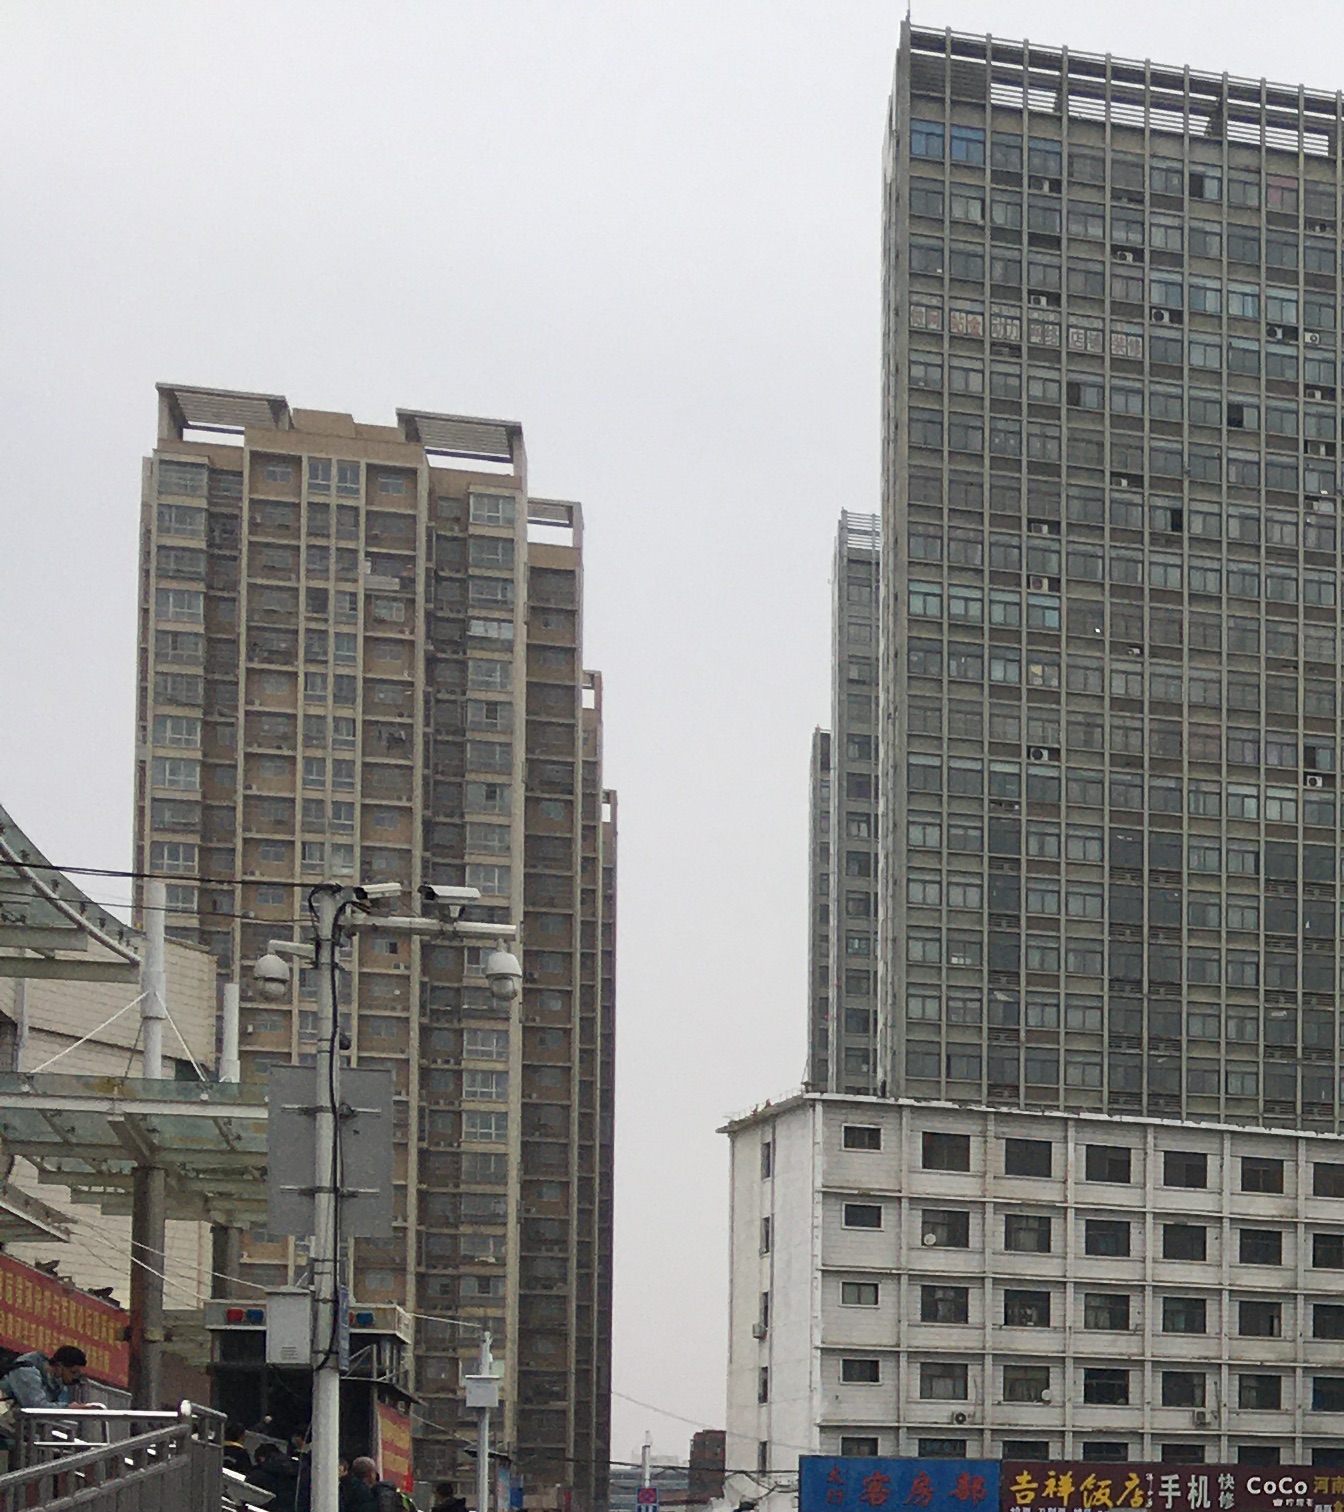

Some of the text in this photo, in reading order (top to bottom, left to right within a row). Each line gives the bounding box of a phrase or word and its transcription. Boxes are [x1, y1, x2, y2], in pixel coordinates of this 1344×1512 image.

[858, 1470, 987, 1508] 客房部
[1010, 1470, 1146, 1508] 吉祥饭店
[1158, 1473, 1211, 1510] 手机
[1218, 1473, 1236, 1510] 快修
[1246, 1476, 1308, 1495] CoCo
